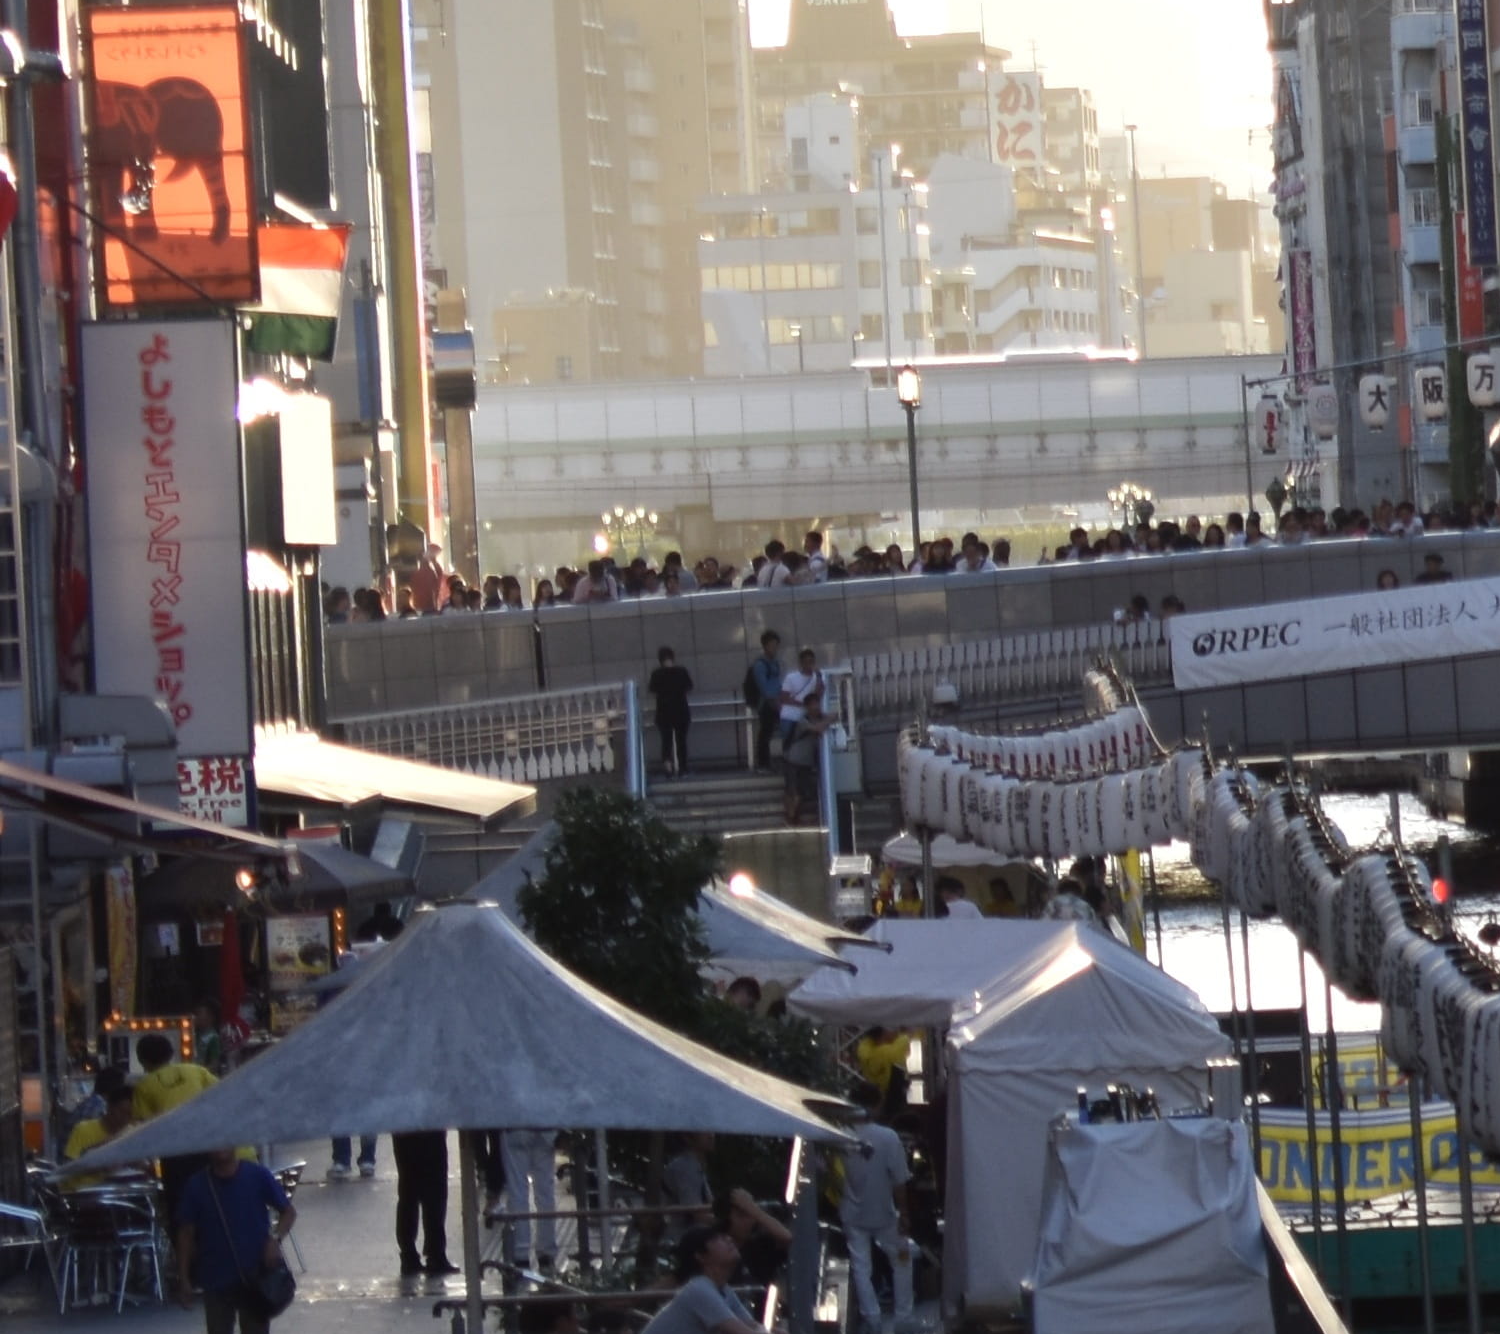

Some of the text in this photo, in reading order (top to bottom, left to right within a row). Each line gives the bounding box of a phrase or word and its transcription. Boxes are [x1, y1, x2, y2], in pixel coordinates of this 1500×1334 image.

[1323, 600, 1478, 637] 一般社団法人
